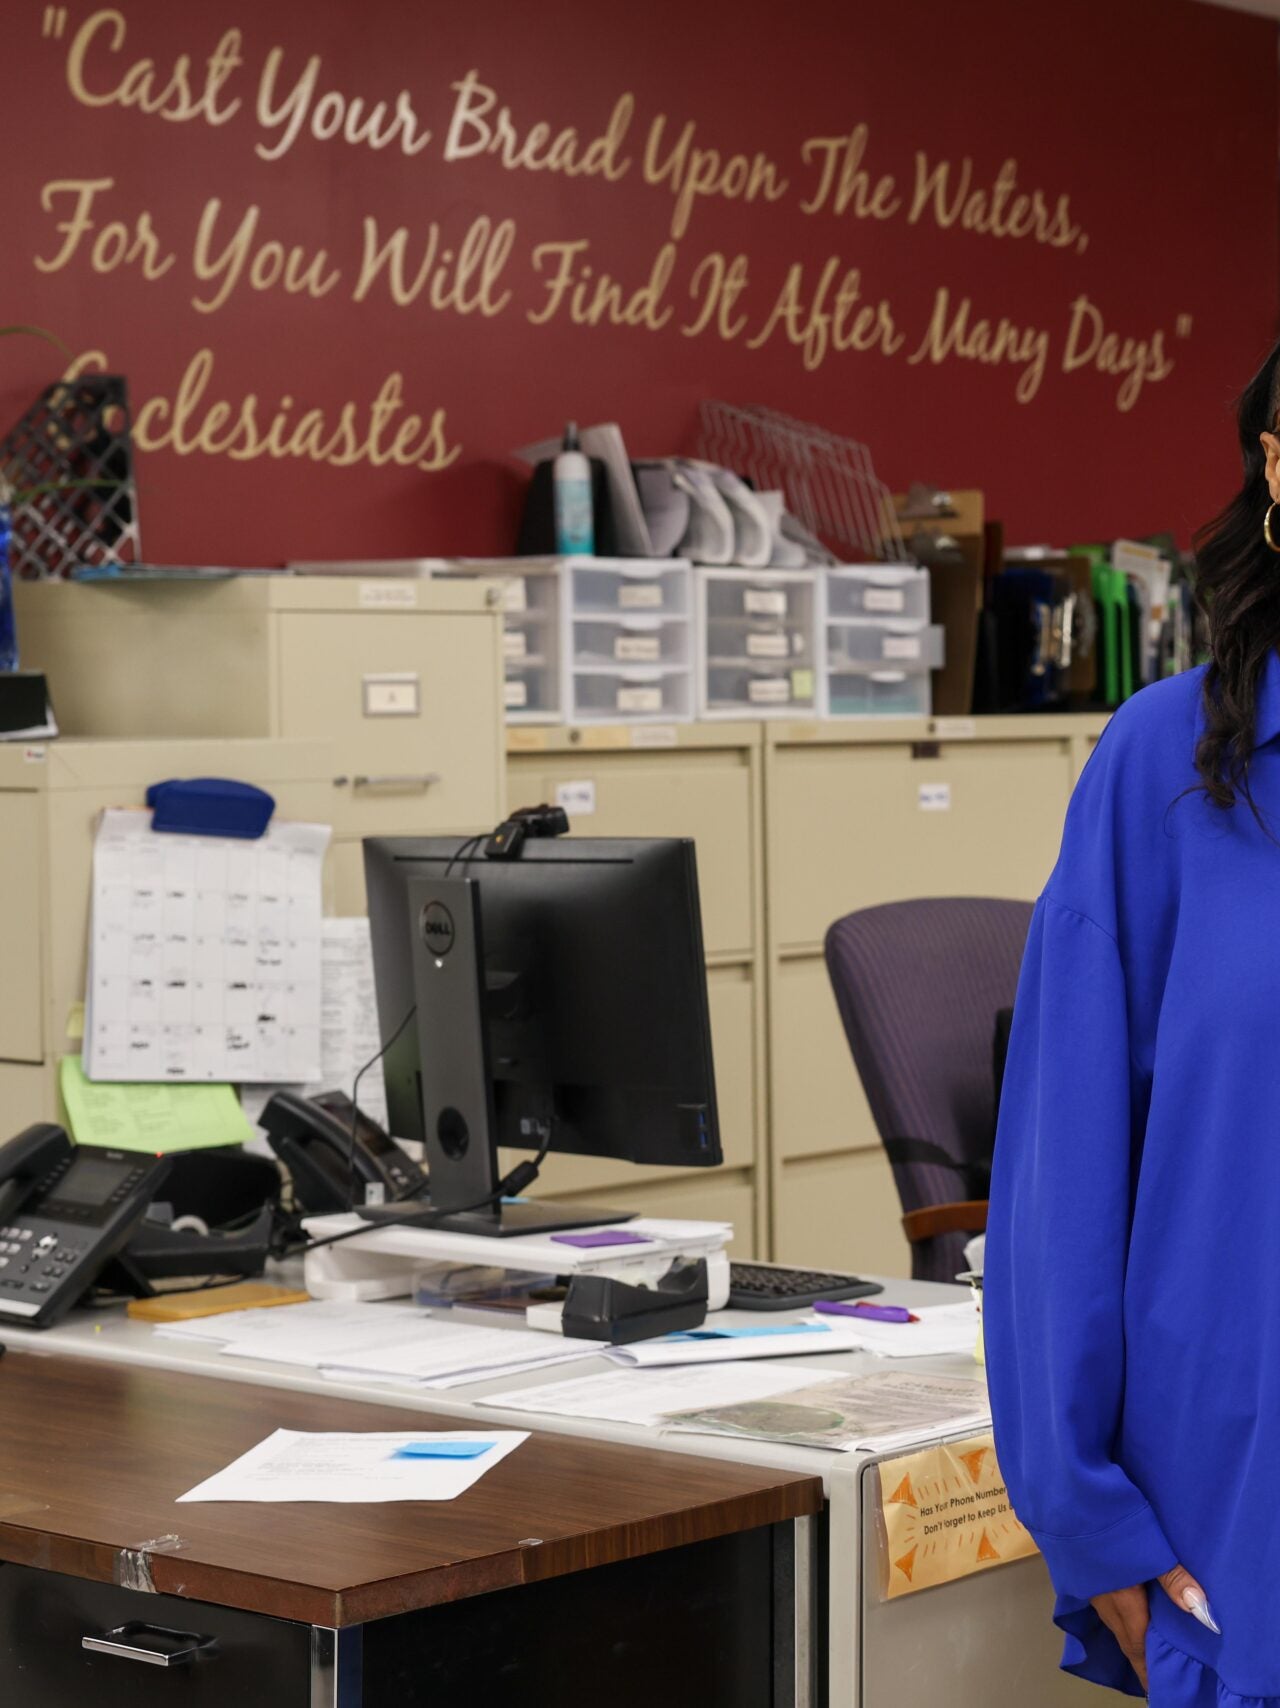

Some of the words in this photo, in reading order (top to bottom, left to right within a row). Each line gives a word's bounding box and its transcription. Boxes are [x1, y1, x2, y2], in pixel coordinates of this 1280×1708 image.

[43, 5, 242, 126] "Cast
[255, 46, 431, 161] Your
[443, 69, 635, 181] Bread
[643, 114, 789, 242] Upon
[799, 123, 900, 219] The
[907, 150, 1090, 255] Waters,
[34, 178, 175, 280] For
[191, 198, 341, 313] You
[352, 215, 515, 317] Will
[526, 240, 676, 331] Find
[682, 252, 748, 341] It
[745, 255, 905, 371] After
[906, 287, 1050, 403] Many
[1062, 295, 1193, 412] Days"
[920, 1506, 934, 1518] Has
[950, 1495, 975, 1508] Phone
[924, 1521, 943, 1536] Don't
[967, 1512, 976, 1522] to
[977, 1507, 996, 1520] Keep
[997, 1503, 1007, 1513] Us
